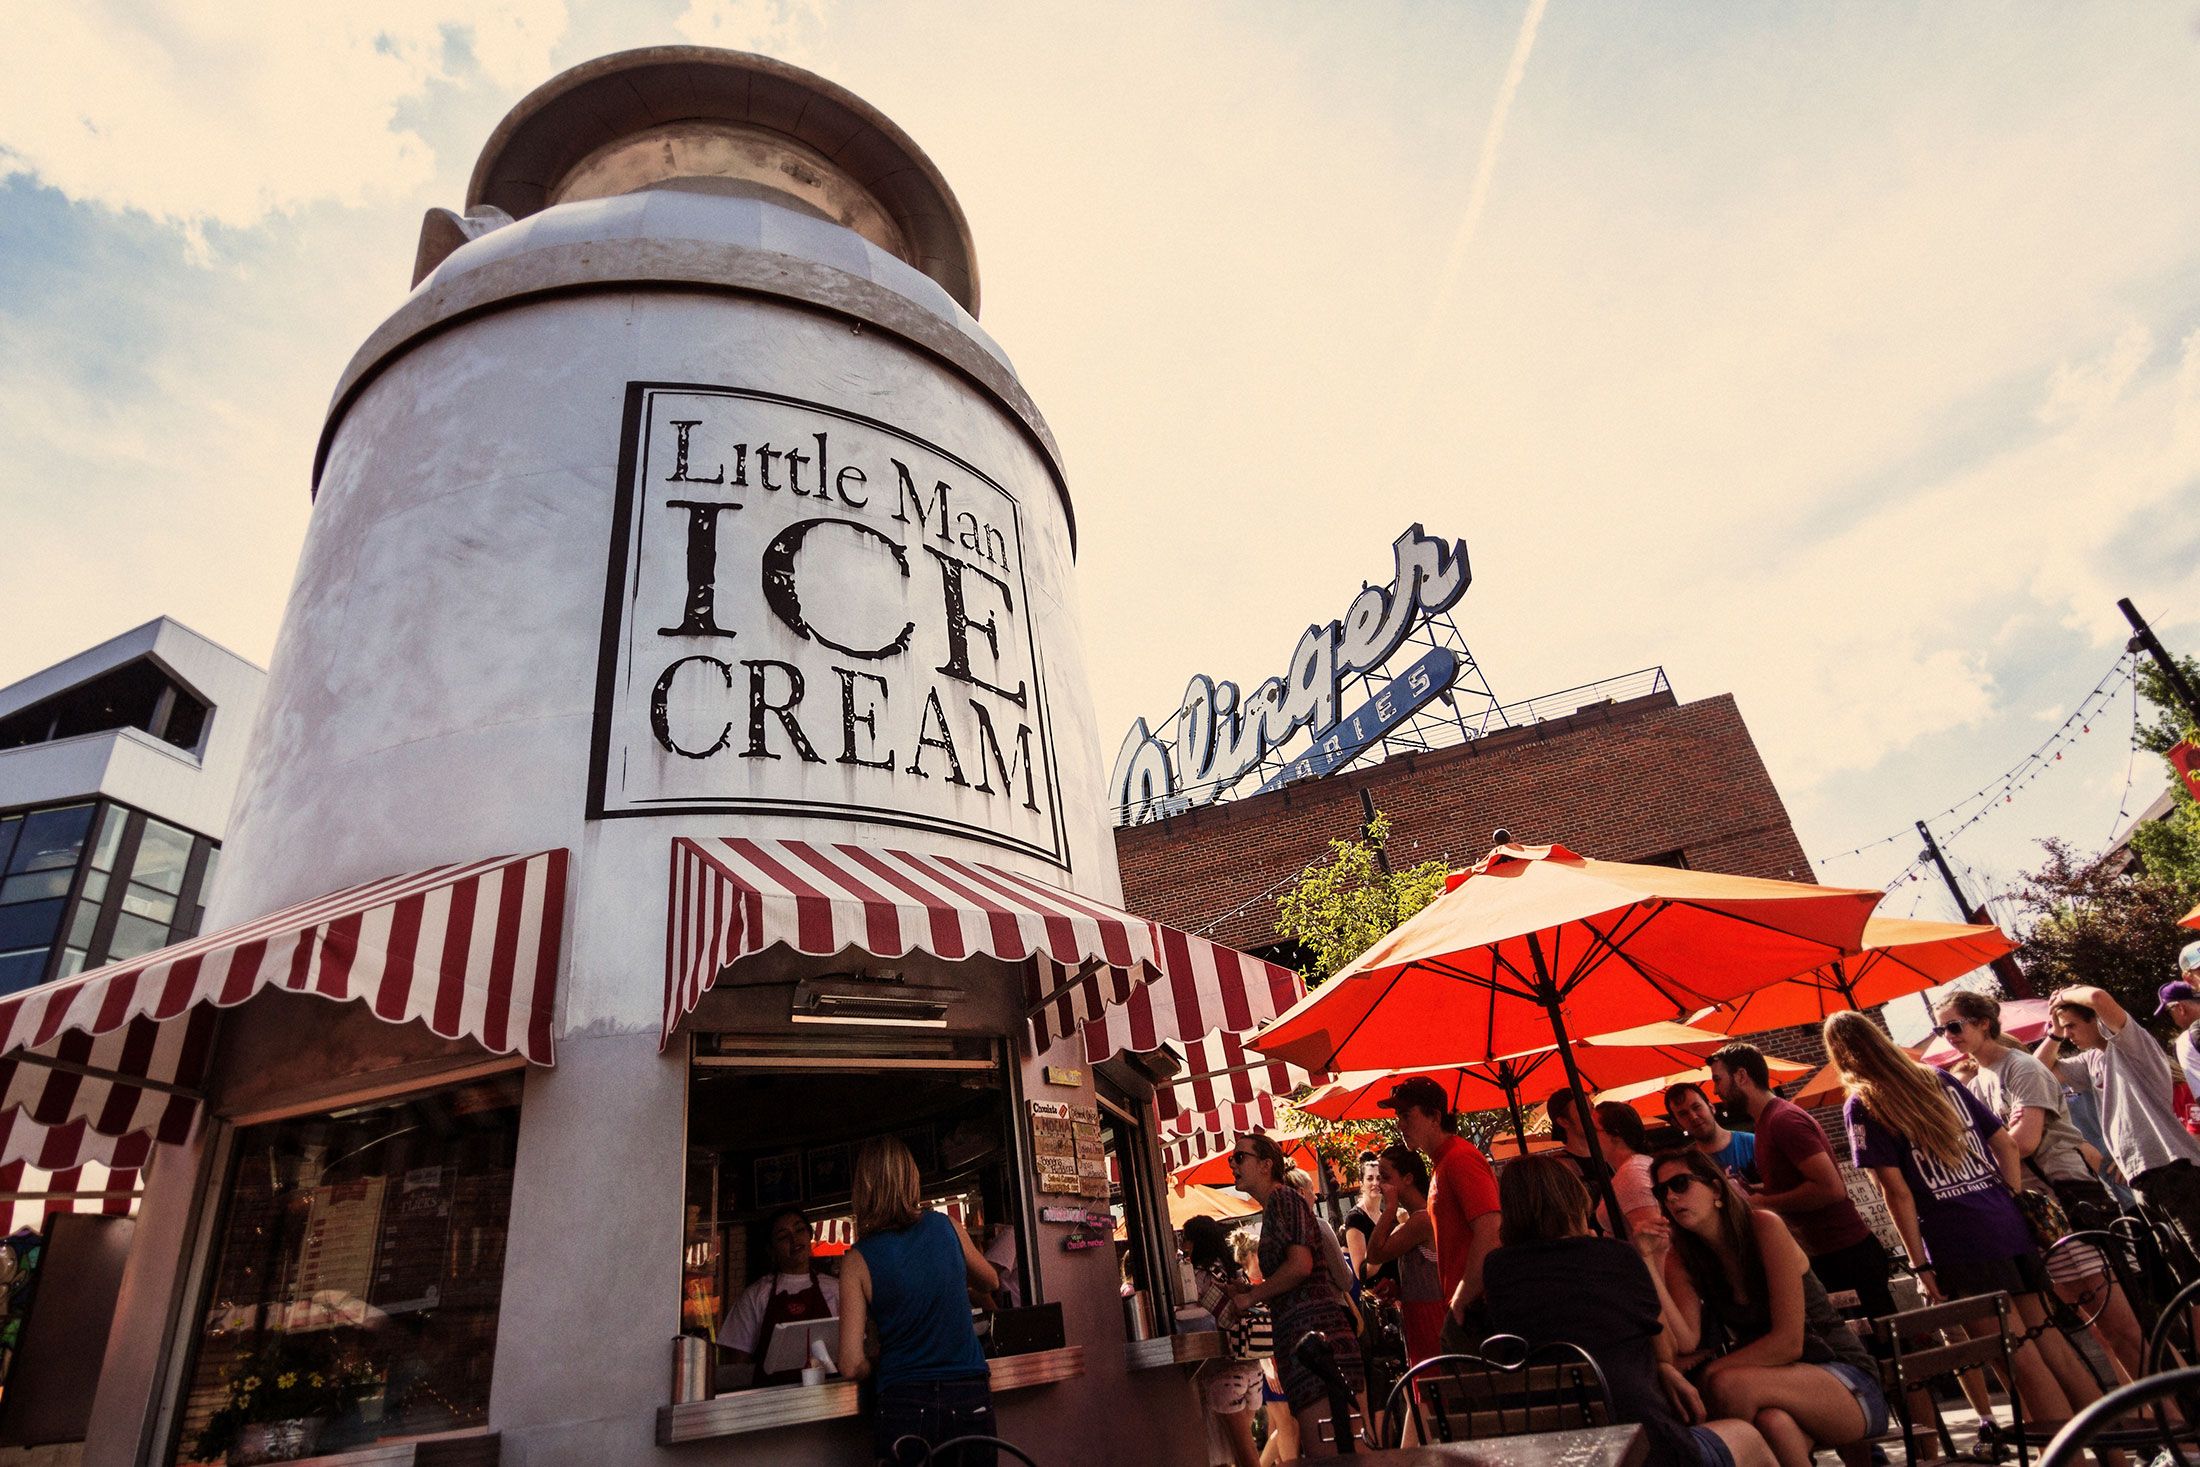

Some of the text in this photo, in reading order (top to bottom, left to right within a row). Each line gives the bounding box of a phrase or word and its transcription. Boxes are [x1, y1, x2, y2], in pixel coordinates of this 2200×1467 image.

[666, 420, 1011, 573] Little Man
[657, 500, 1027, 710] ICE
[650, 655, 1042, 815] CREAM
[1268, 664, 1431, 790] ARIES
